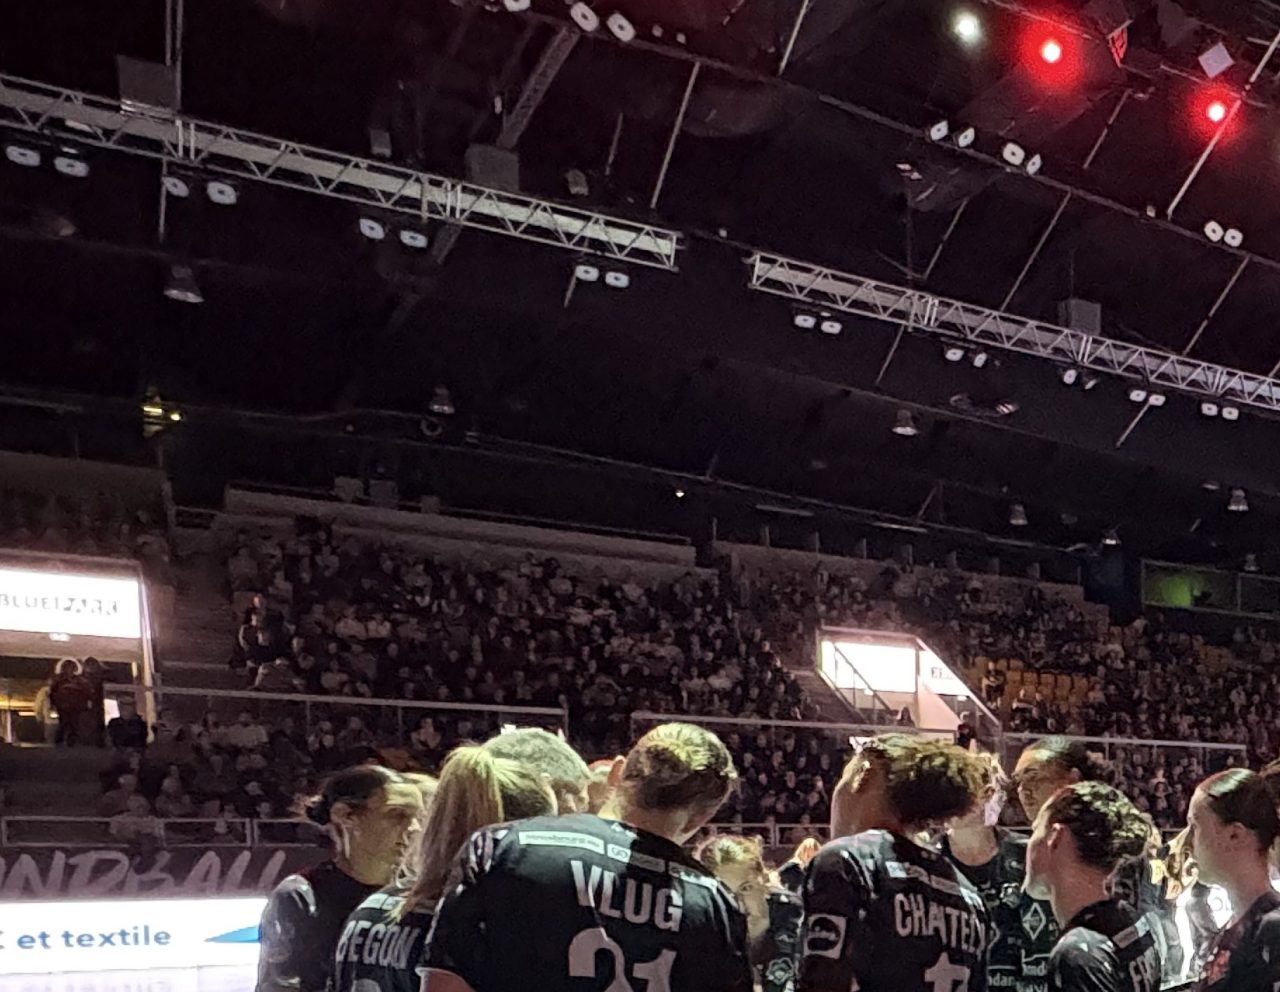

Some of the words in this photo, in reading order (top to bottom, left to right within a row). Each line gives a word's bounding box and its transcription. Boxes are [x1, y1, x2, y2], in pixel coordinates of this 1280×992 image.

[570, 860, 683, 932] VLUG
[17, 930, 51, 949] et
[62, 925, 171, 947] textile
